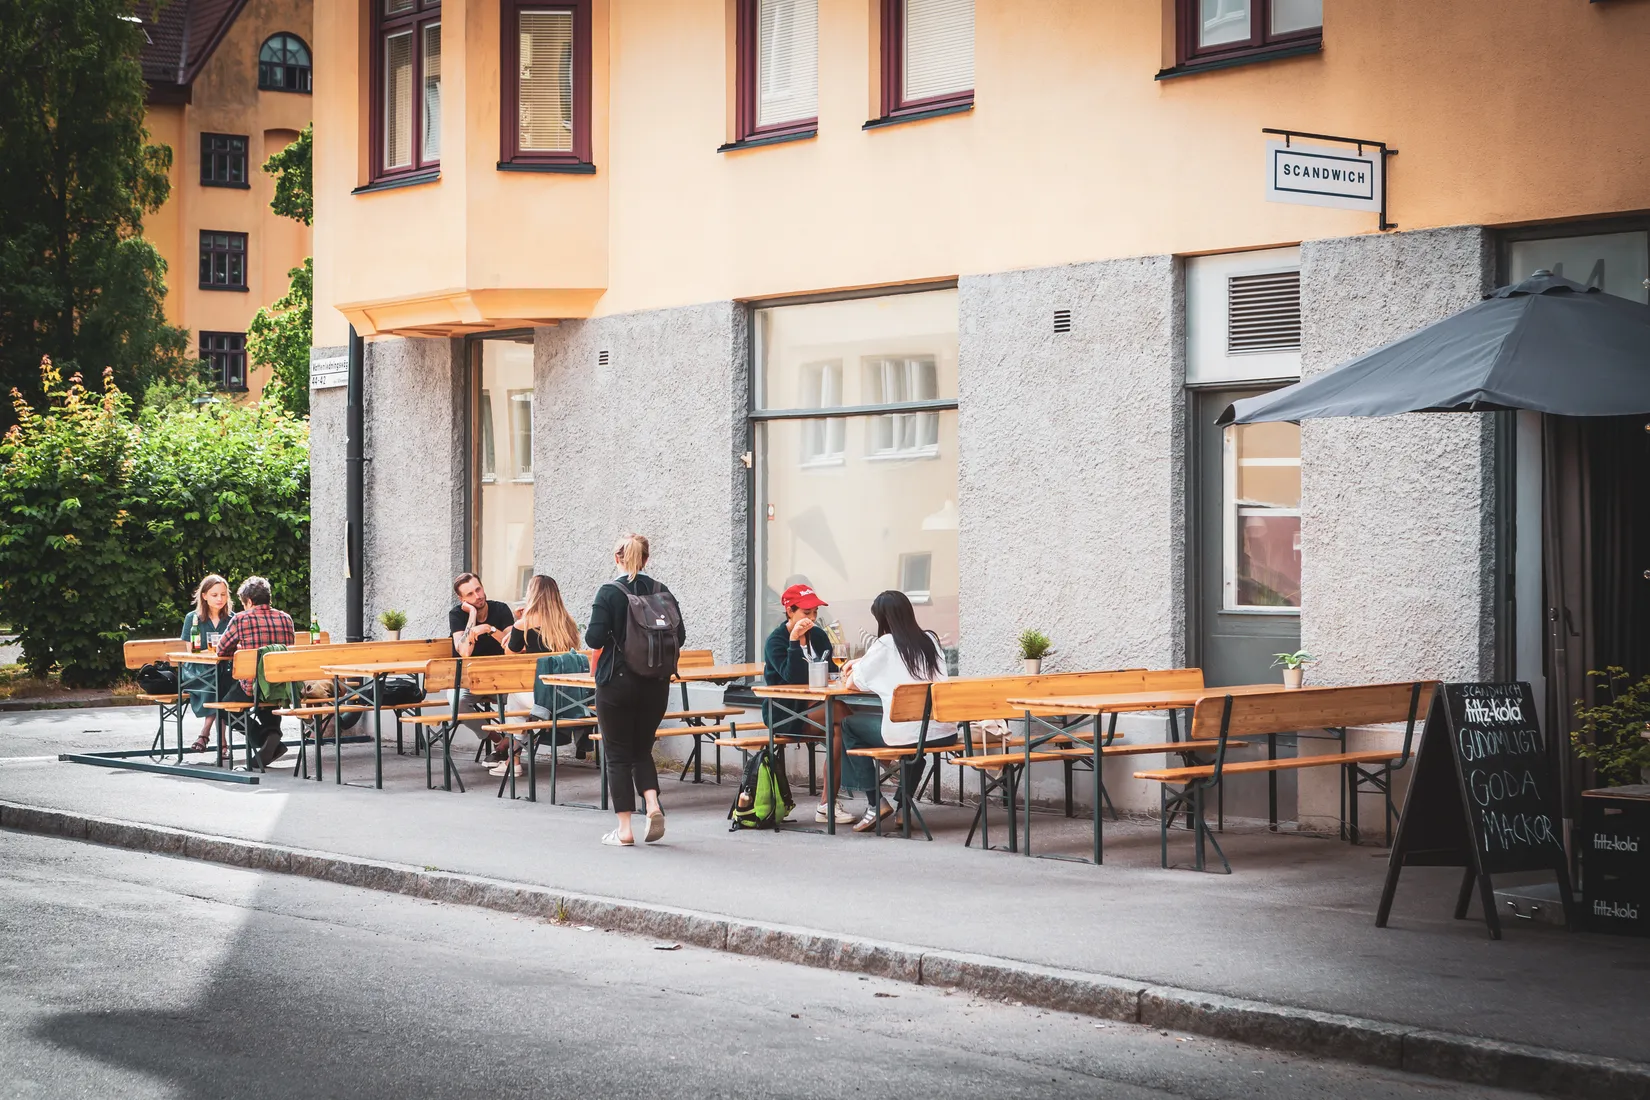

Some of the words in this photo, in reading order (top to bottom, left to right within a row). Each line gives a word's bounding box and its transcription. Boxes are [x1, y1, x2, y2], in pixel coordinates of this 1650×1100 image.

[1283, 163, 1365, 184] SCANDWICH
[1462, 684, 1523, 698] SCANDWICH
[1465, 698, 1523, 723] fritz-kola
[1470, 768, 1541, 806] GODA
[1482, 809, 1563, 852] MACKOR
[1593, 832, 1639, 852] fritz-kola
[1593, 899, 1639, 920] fritz-kola
